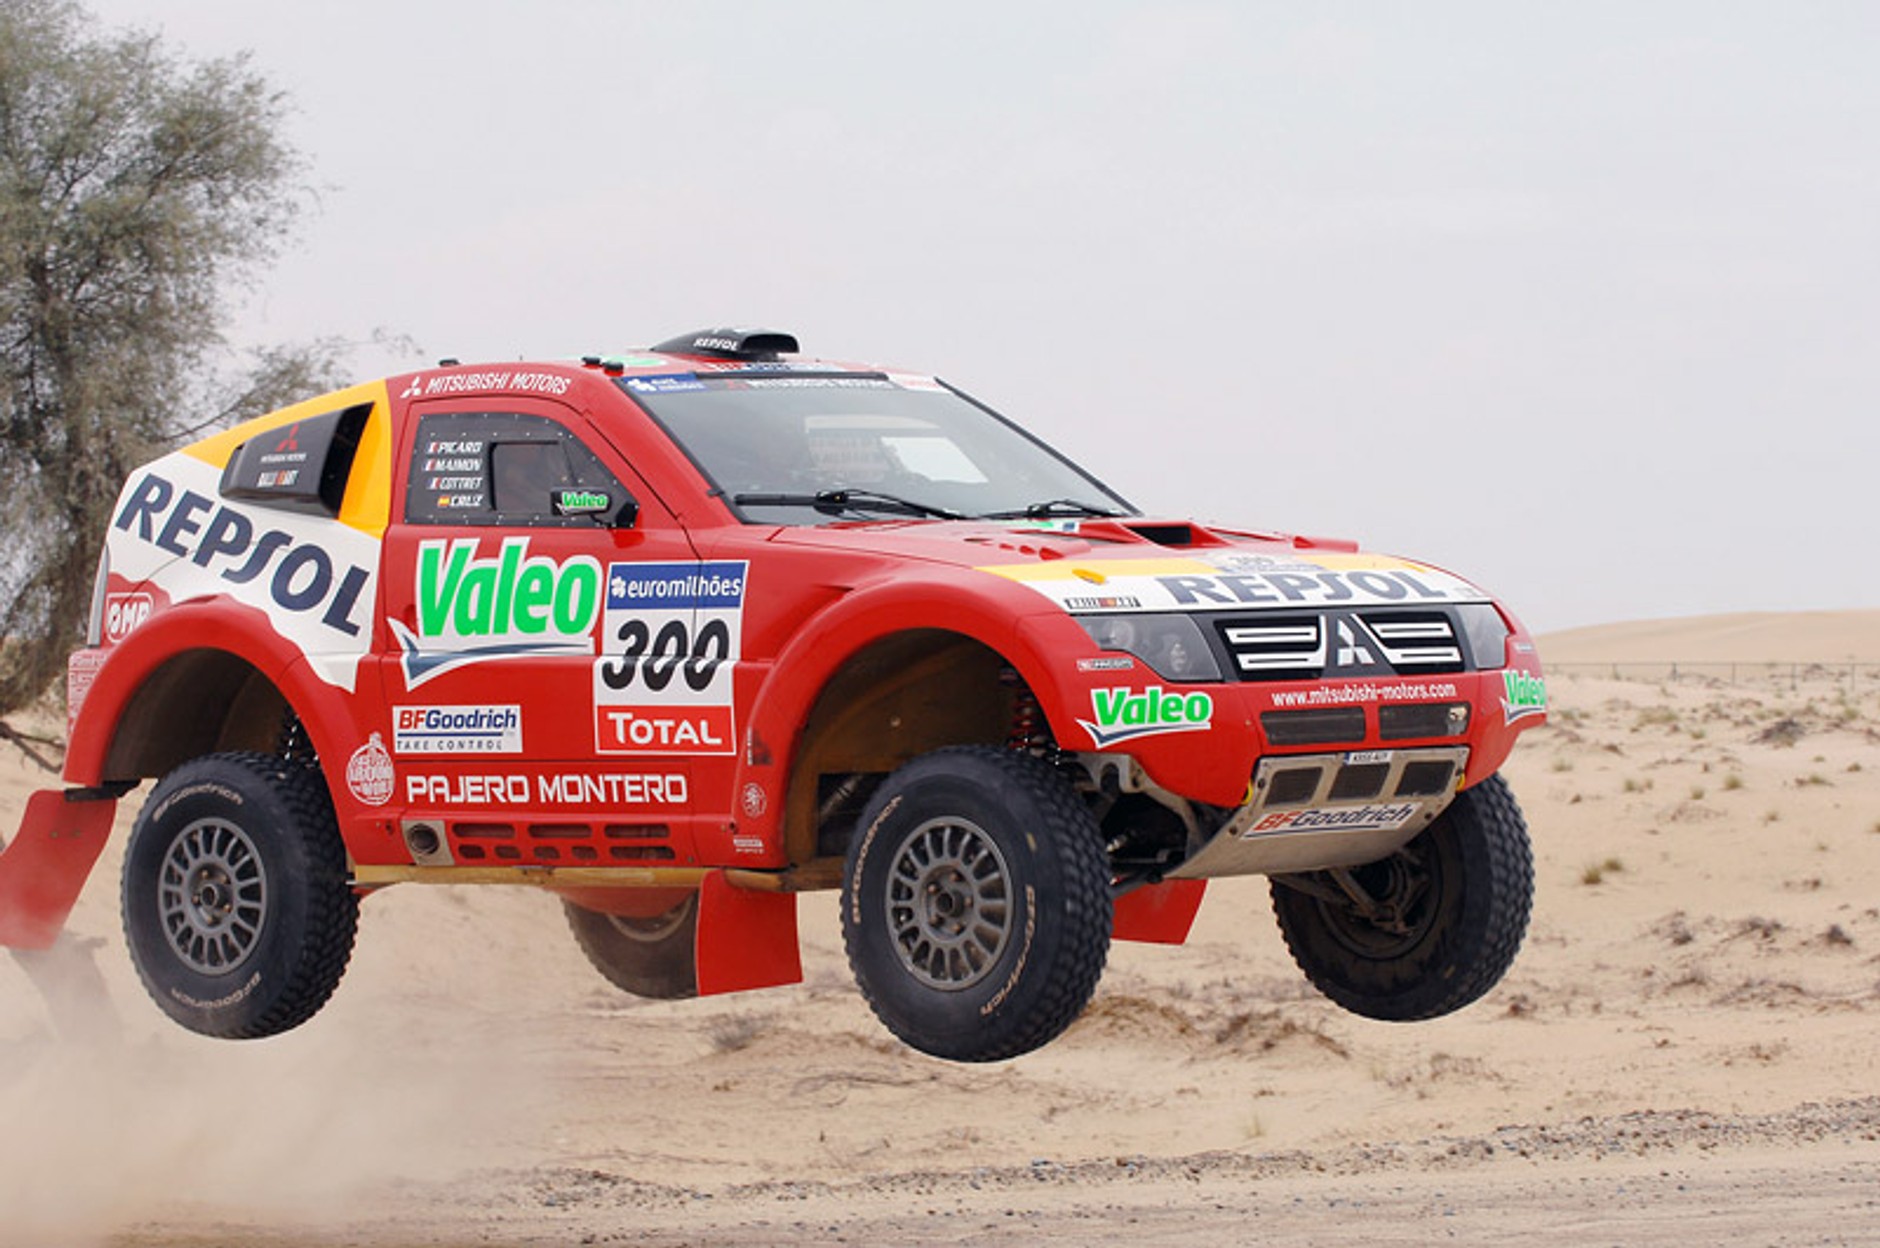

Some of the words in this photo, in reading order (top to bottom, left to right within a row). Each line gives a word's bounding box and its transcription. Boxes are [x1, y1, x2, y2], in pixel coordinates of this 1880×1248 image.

[425, 373, 510, 394] MITSUBISHI
[510, 373, 572, 394] MOTORS
[437, 442, 483, 454] PICARD
[450, 495, 483, 507] CRUZ
[561, 491, 608, 507] Valeo
[115, 472, 370, 637] REPSOL
[421, 545, 597, 637] Valeo
[627, 575, 742, 597] euromilhões
[1155, 571, 1447, 605] REPSOL
[602, 619, 730, 692] 300
[1271, 683, 1457, 706] www.mitsubishi-motors.com
[1094, 688, 1211, 726] Valeo
[399, 709, 517, 730] BFGoodrich
[397, 740, 430, 751] TAKE
[437, 740, 503, 751] CONTROL
[406, 775, 530, 803] PAJERO
[538, 774, 688, 803] MONTERO
[1253, 802, 1414, 832] BFGoodrich
